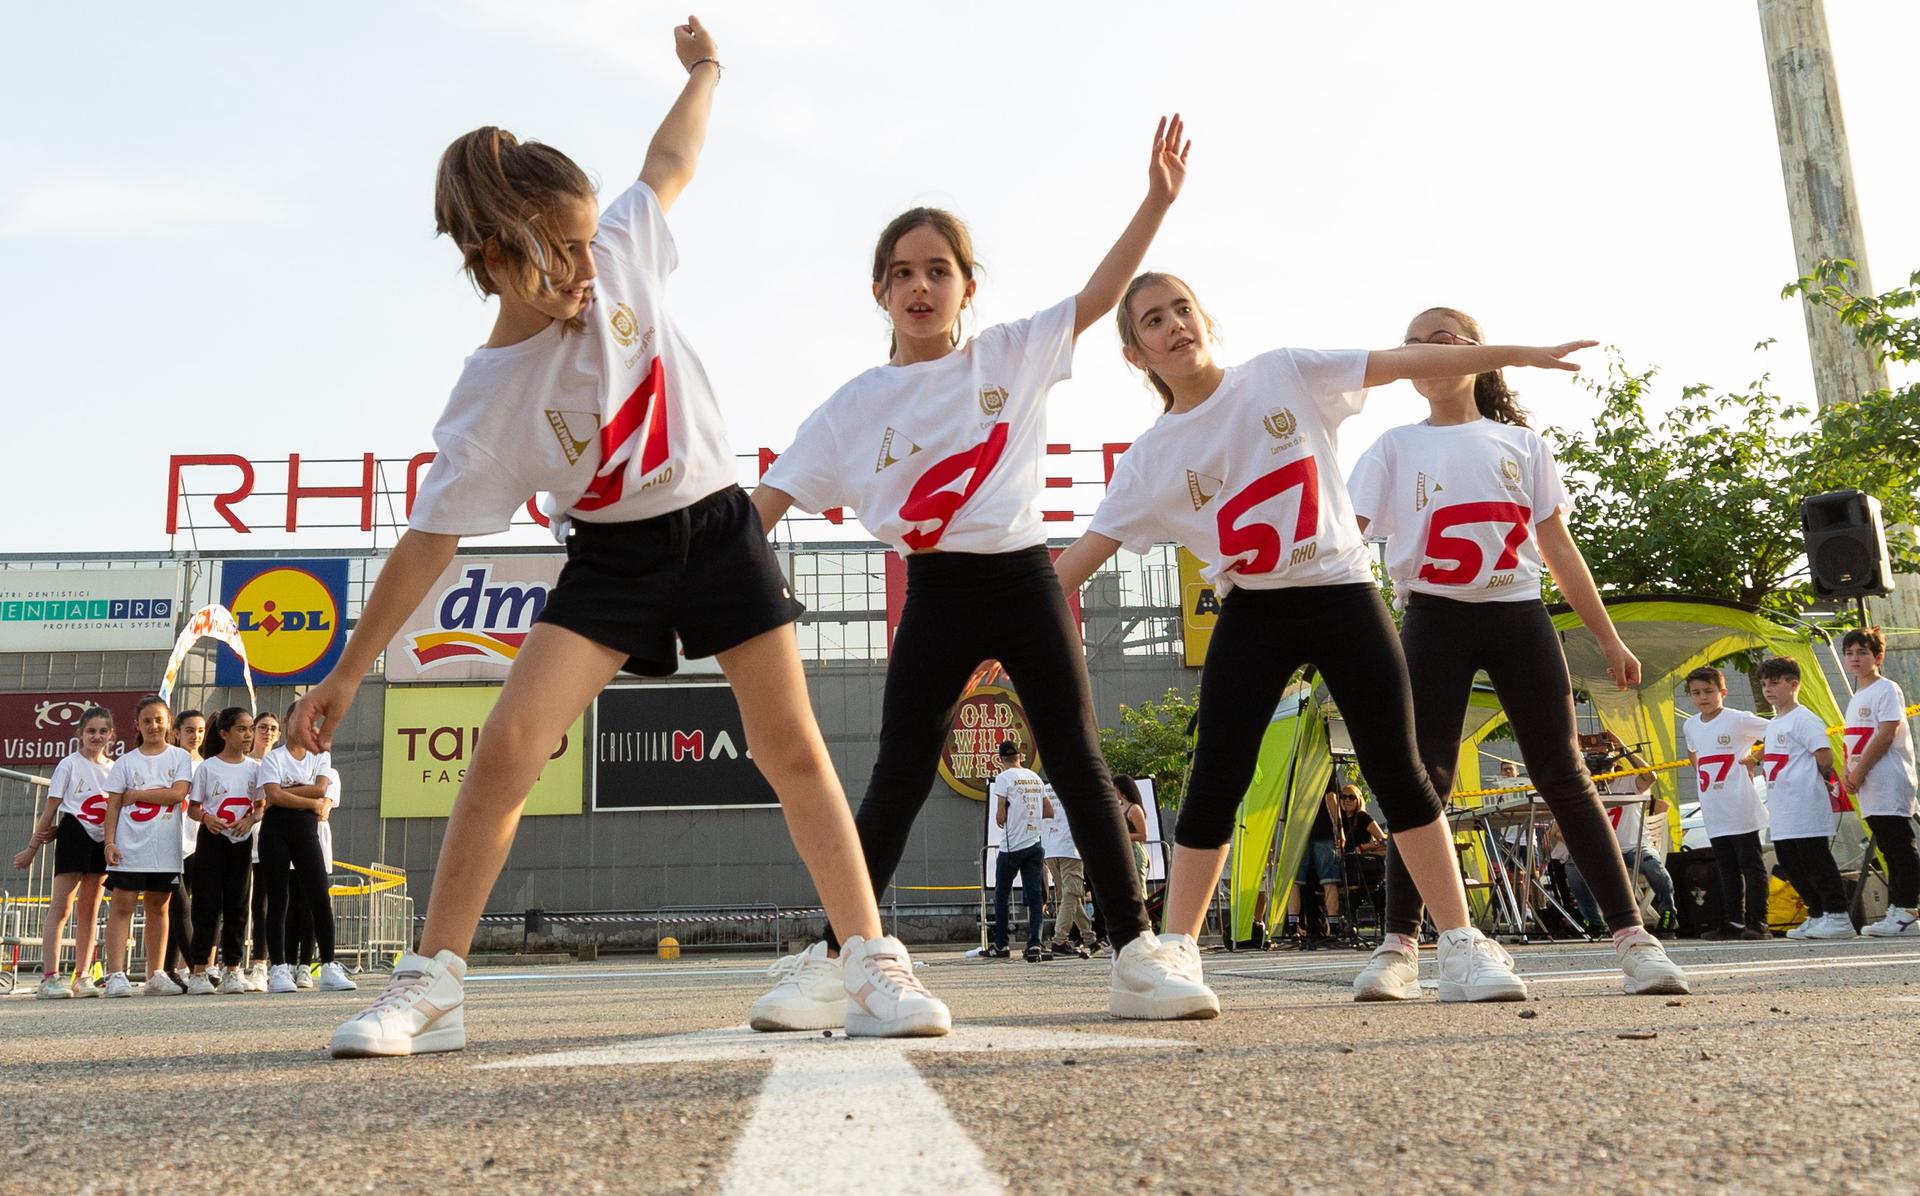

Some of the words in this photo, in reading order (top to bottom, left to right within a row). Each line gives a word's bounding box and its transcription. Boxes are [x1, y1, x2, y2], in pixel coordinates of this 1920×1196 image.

[1290, 541, 1318, 567] RHO
[28, 590, 90, 598] DENTISTICI
[43, 622, 125, 630] PROFESSIONAL
[131, 621, 171, 629] SYSTEM
[960, 703, 1013, 728] OLD
[950, 752, 1026, 779] WES
